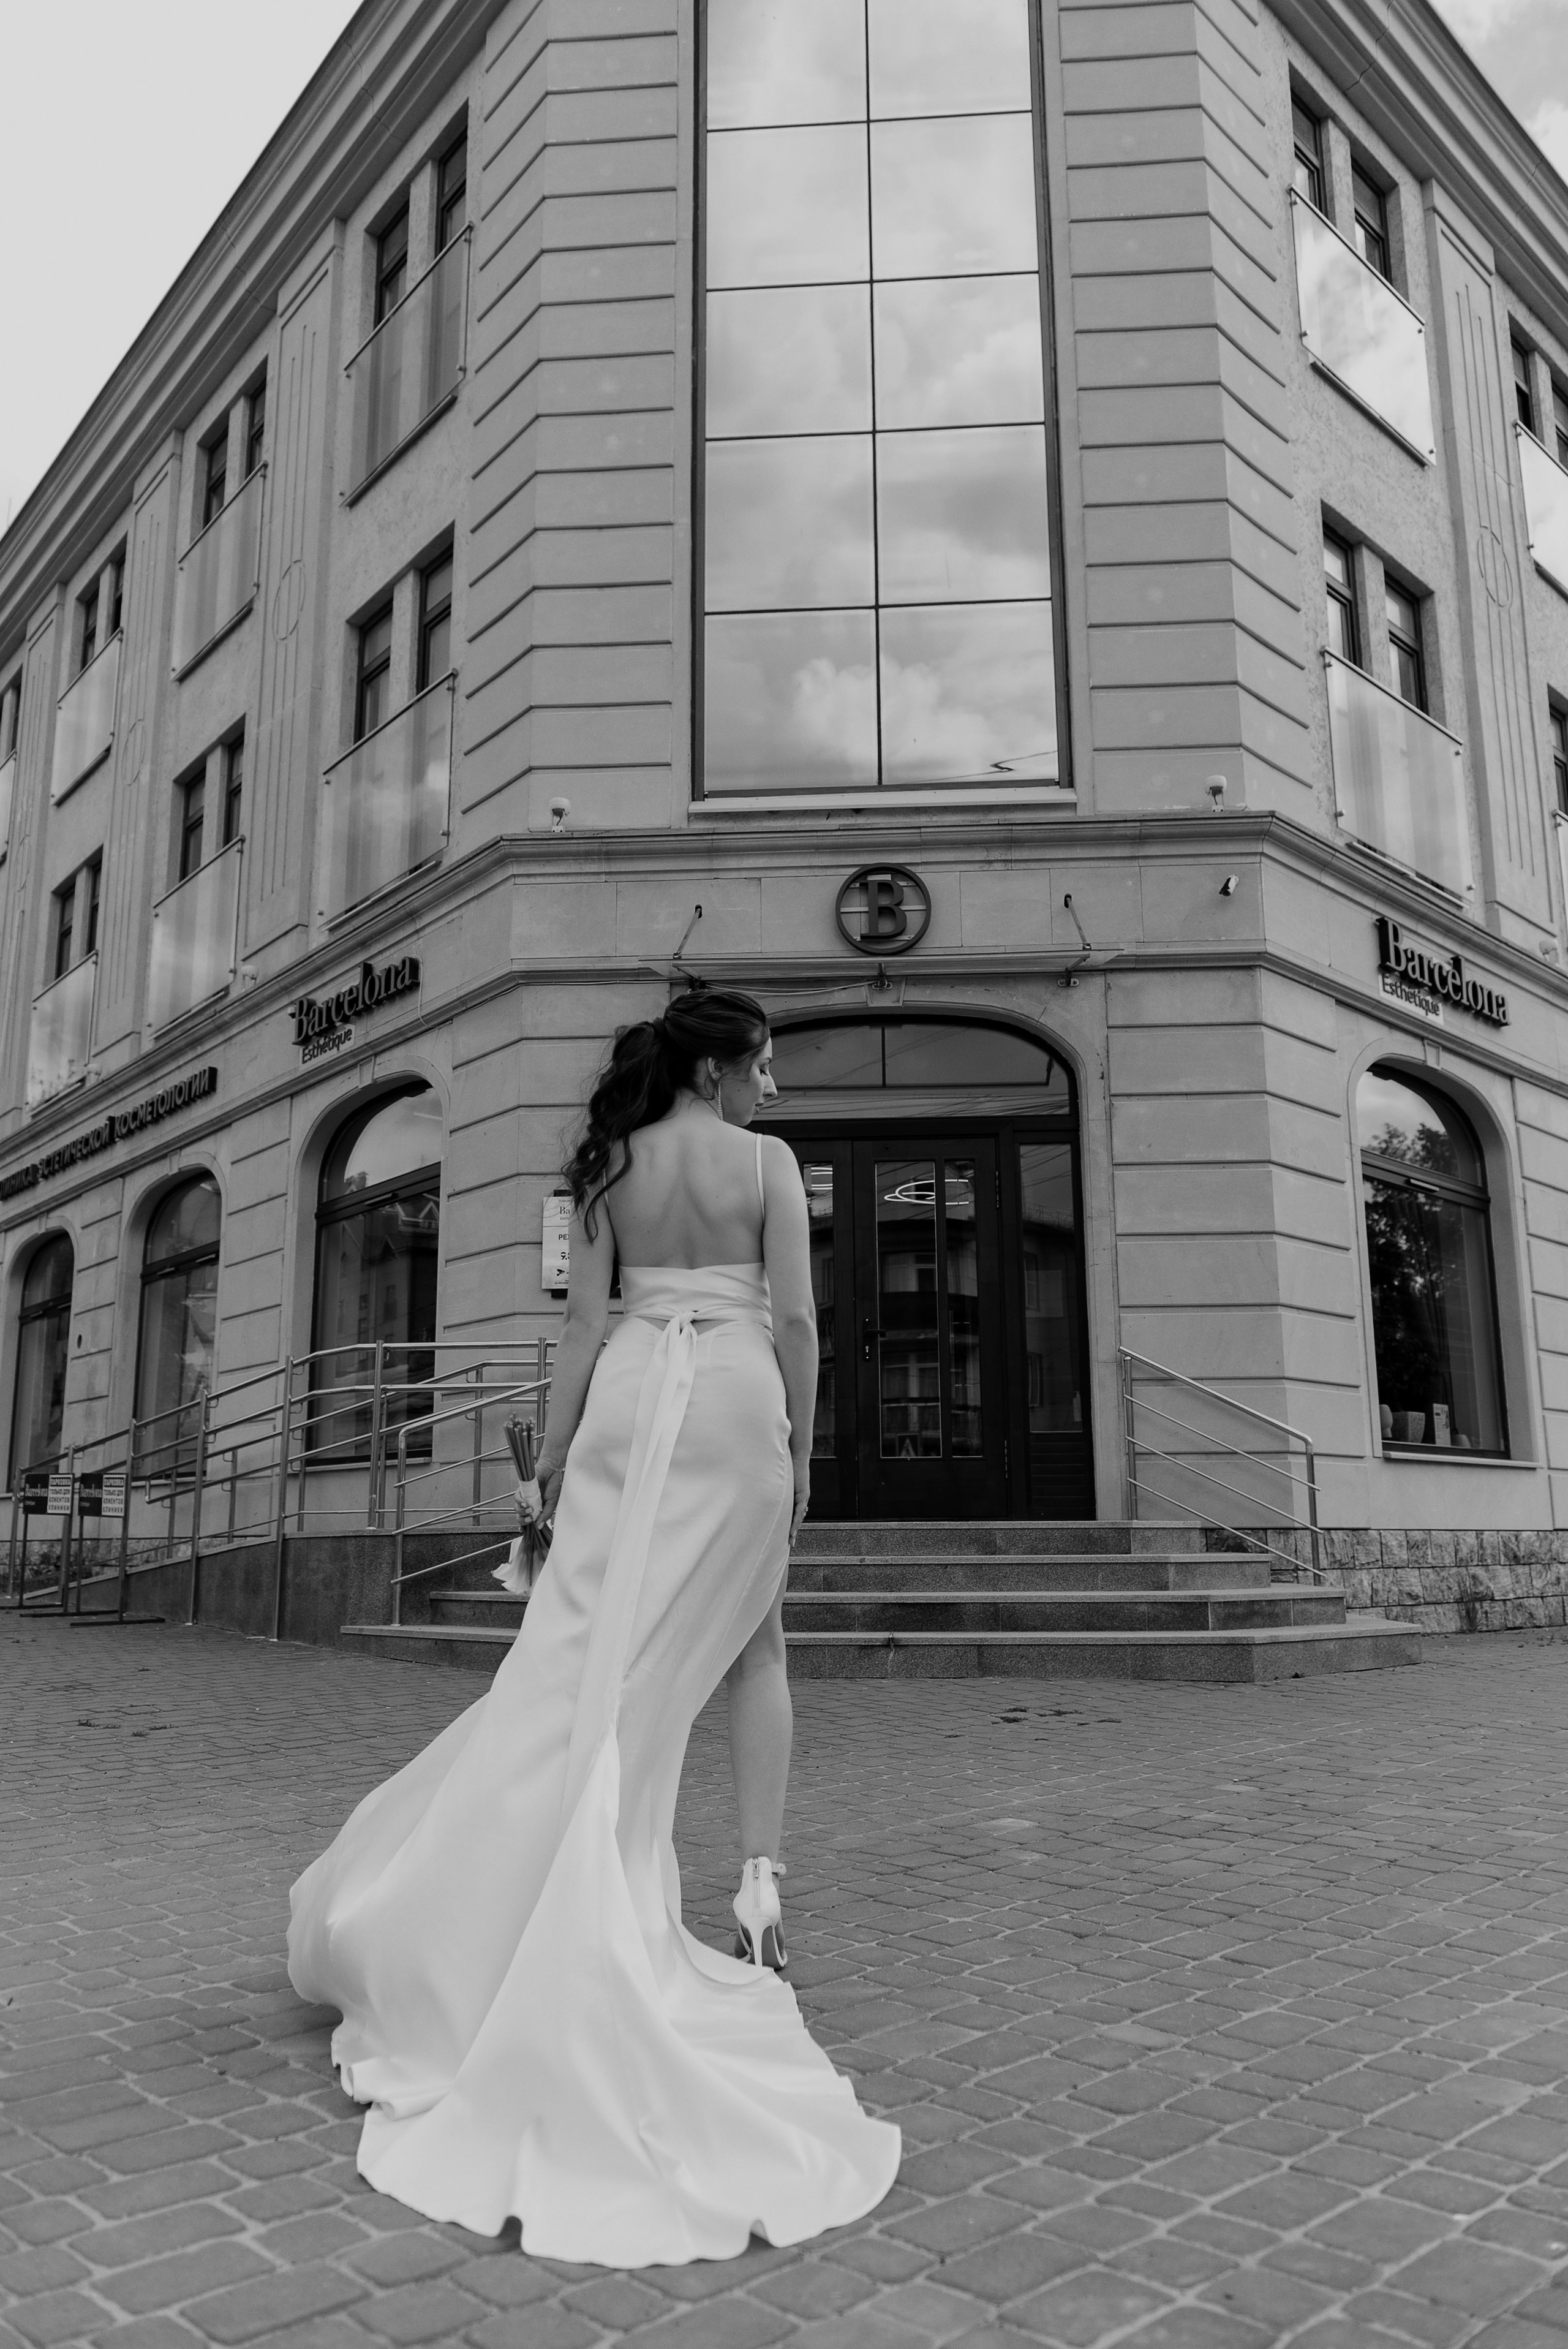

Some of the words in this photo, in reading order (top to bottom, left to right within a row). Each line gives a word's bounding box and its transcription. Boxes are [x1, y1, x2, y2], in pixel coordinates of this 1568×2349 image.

[859, 879, 907, 939] B
[1376, 917, 1511, 1027] Barcelona
[292, 956, 420, 1045] Barcelona
[302, 1028, 352, 1064] Esthétique
[0, 1164, 37, 1199] ЛИНИКА
[37, 1116, 115, 1178] ЭСТЕТИЧЕСКОЙ
[115, 1067, 217, 1138] КОСМЕТОЛОГИИ
[560, 1206, 570, 1214] Ba
[25, 1483, 48, 1497] Barcelona
[80, 1484, 102, 1498] Barcelona
